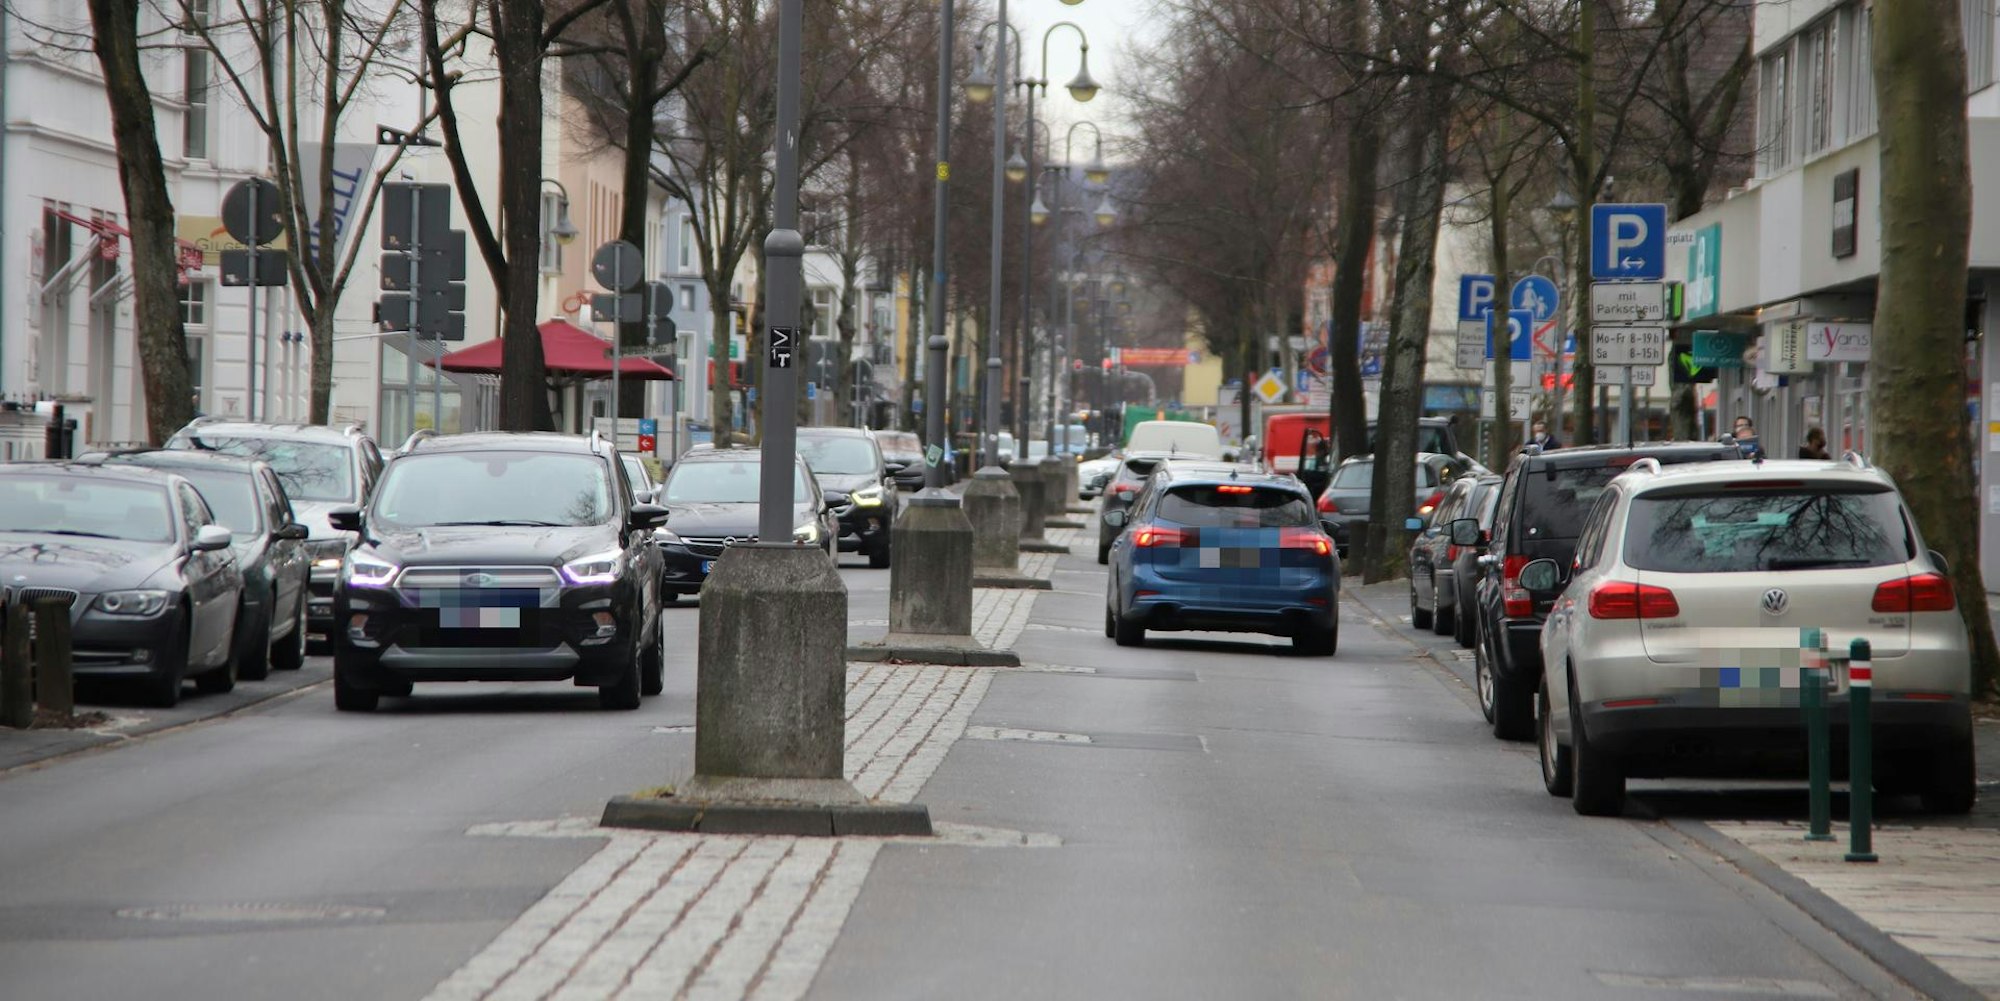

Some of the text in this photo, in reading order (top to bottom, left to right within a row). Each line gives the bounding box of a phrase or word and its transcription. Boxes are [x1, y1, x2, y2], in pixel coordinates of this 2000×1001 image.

[1609, 214, 1648, 269] P
[1469, 281, 1495, 316] P
[1618, 290, 1637, 301] mit
[1597, 303, 1659, 315] Parkschein
[1596, 333, 1626, 344] Mo-Fr
[1596, 348, 1608, 359] Sa
[1597, 370, 1607, 380] Sa
